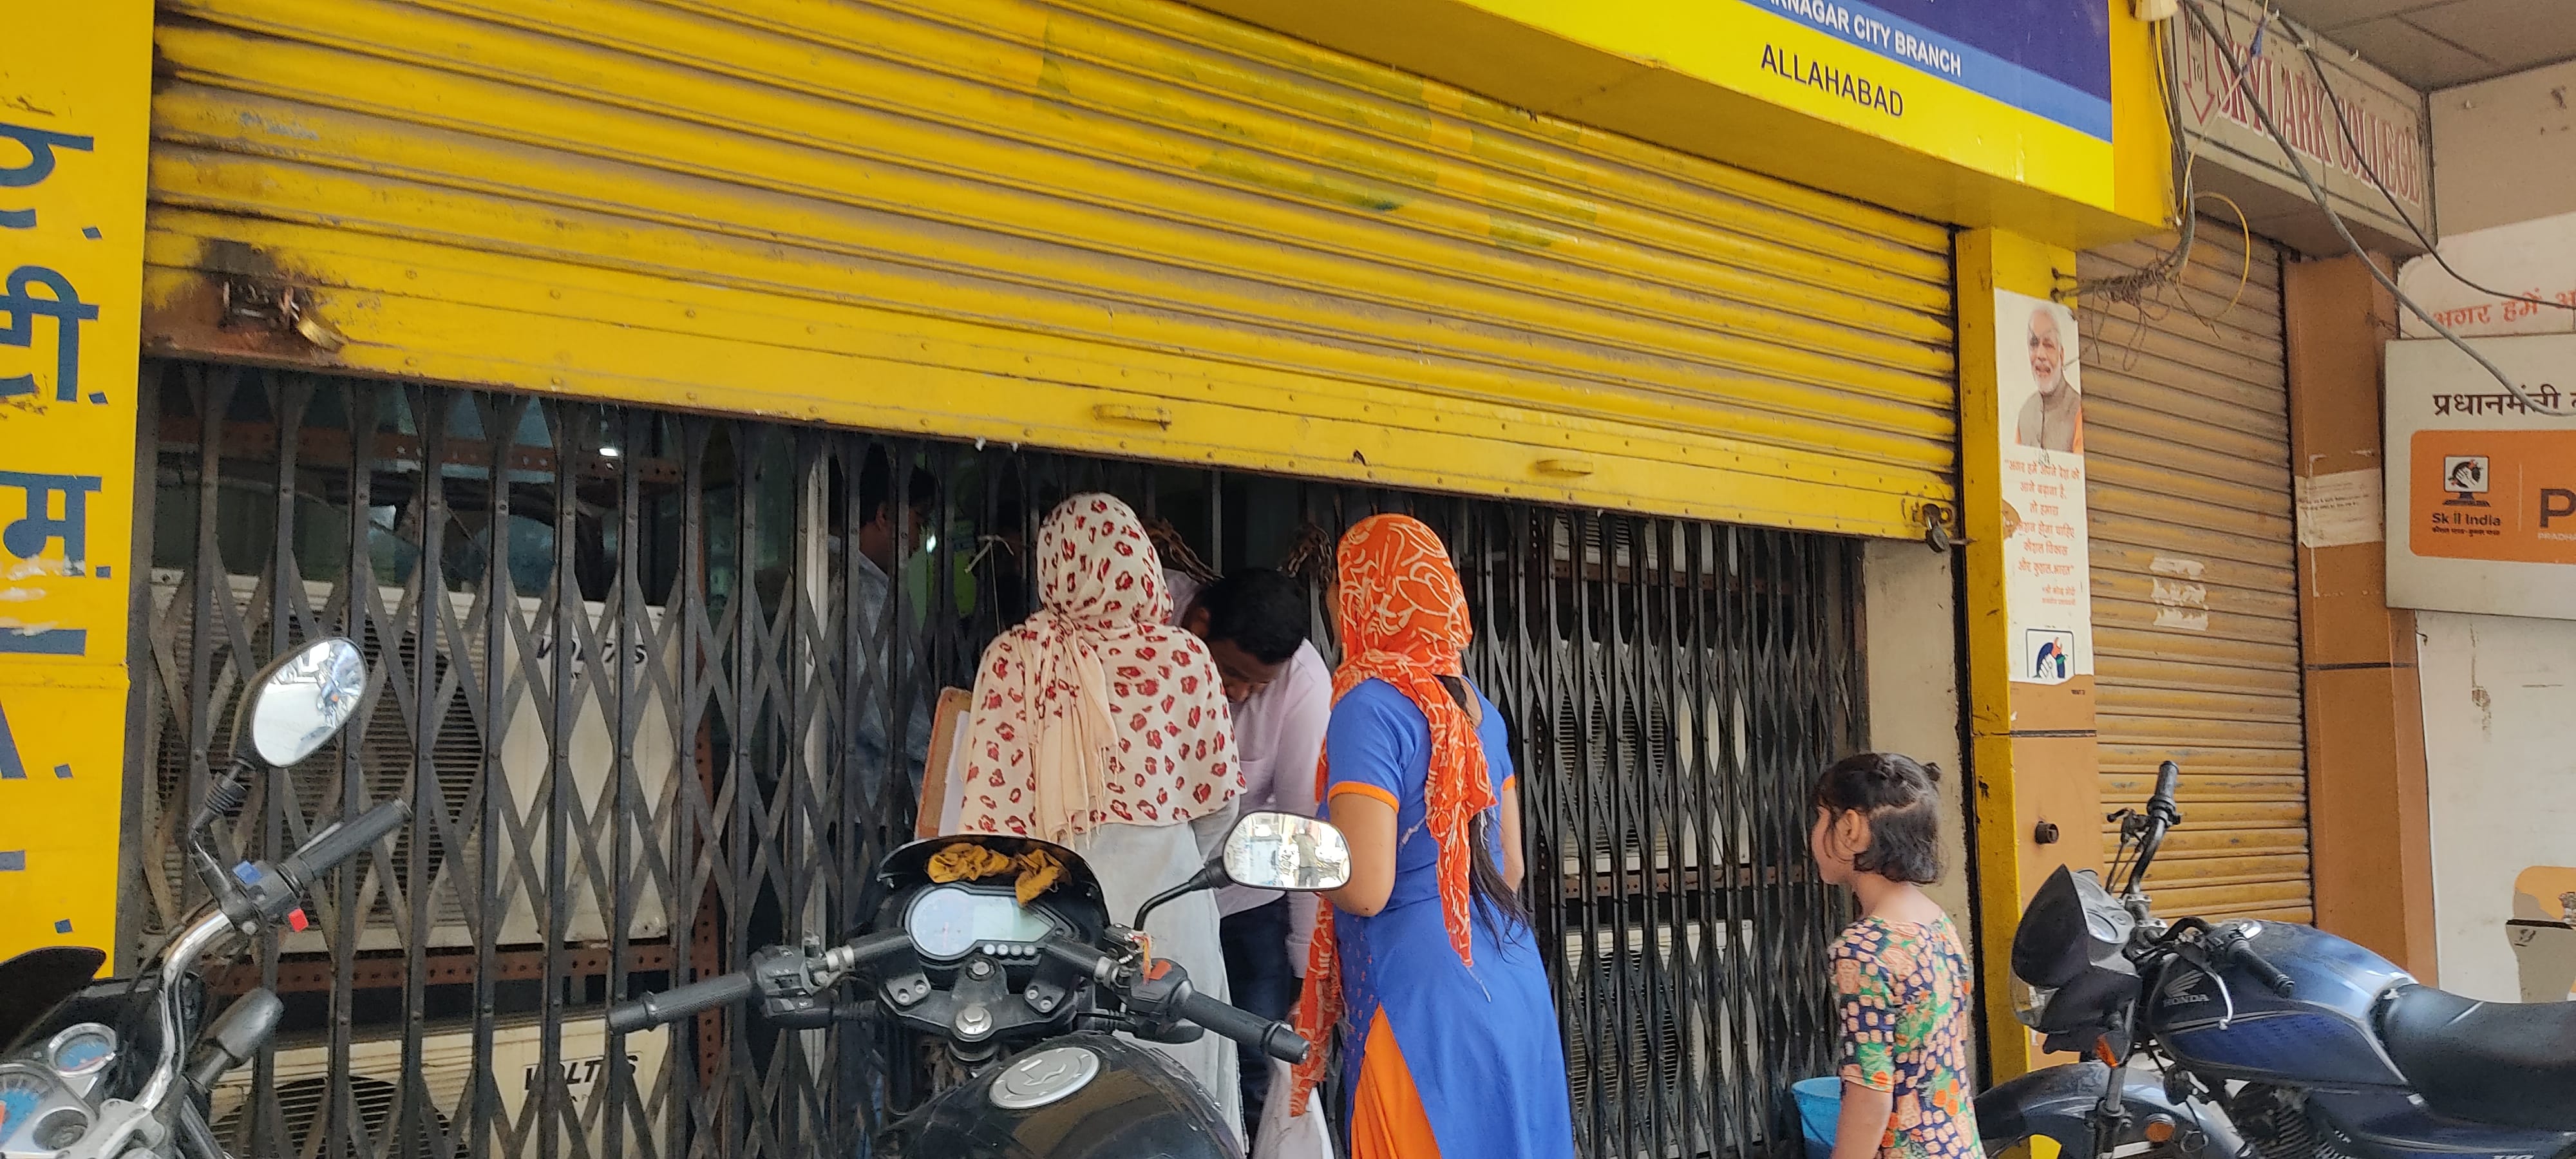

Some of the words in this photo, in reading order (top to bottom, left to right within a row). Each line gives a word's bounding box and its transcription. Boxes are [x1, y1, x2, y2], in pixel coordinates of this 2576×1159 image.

[1853, 14, 1891, 50] CITY
[1895, 30, 1962, 77] BRANCH
[1761, 43, 1904, 117] ALLAHABAD
[2214, 41, 2334, 167] SKYLARK
[2336, 96, 2421, 207] COLLEGE
[2432, 513, 2461, 524] Skll
[2465, 514, 2501, 526] India
[2164, 994, 2210, 1007] HONDA
